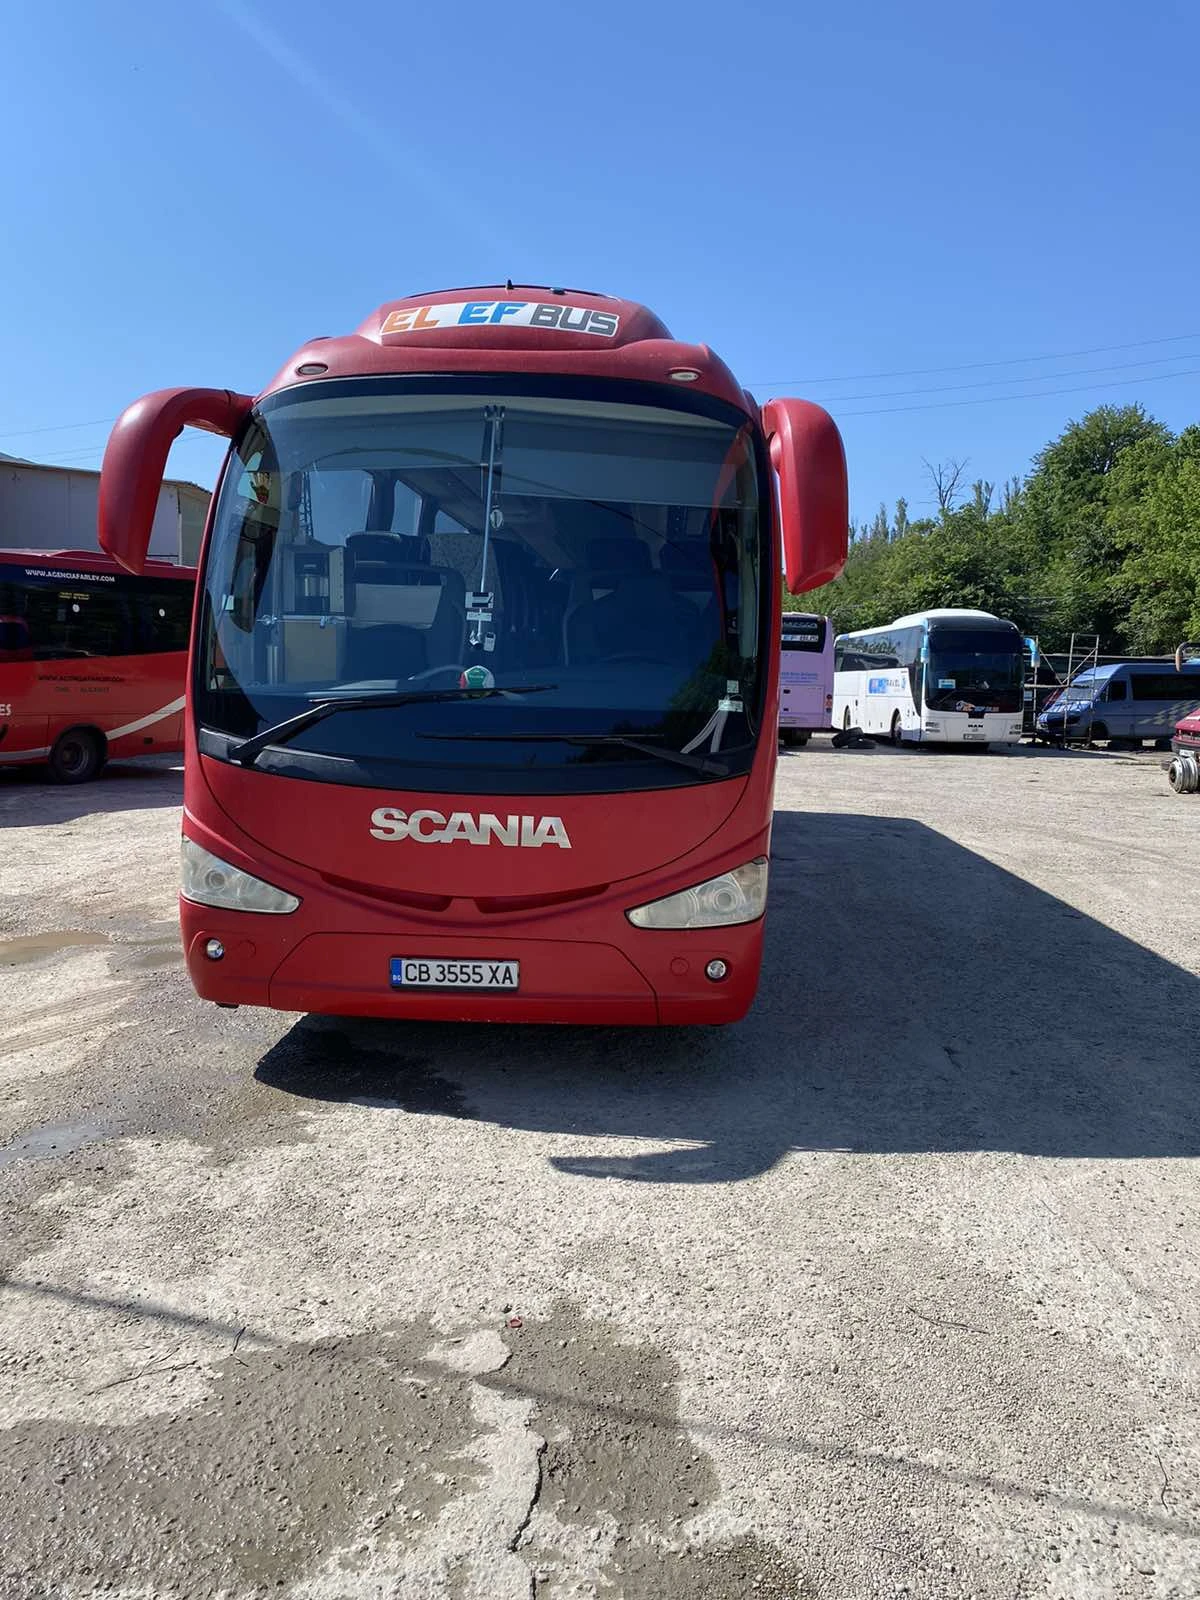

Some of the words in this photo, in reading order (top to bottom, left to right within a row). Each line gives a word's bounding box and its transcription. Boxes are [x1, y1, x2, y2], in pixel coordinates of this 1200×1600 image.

[382, 306, 439, 333] EL
[458, 302, 529, 325] EF
[530, 304, 619, 336] BUS
[369, 807, 573, 849] SCANIA
[404, 963, 431, 983] CB
[435, 963, 484, 984] 3555
[488, 965, 514, 985] XA
